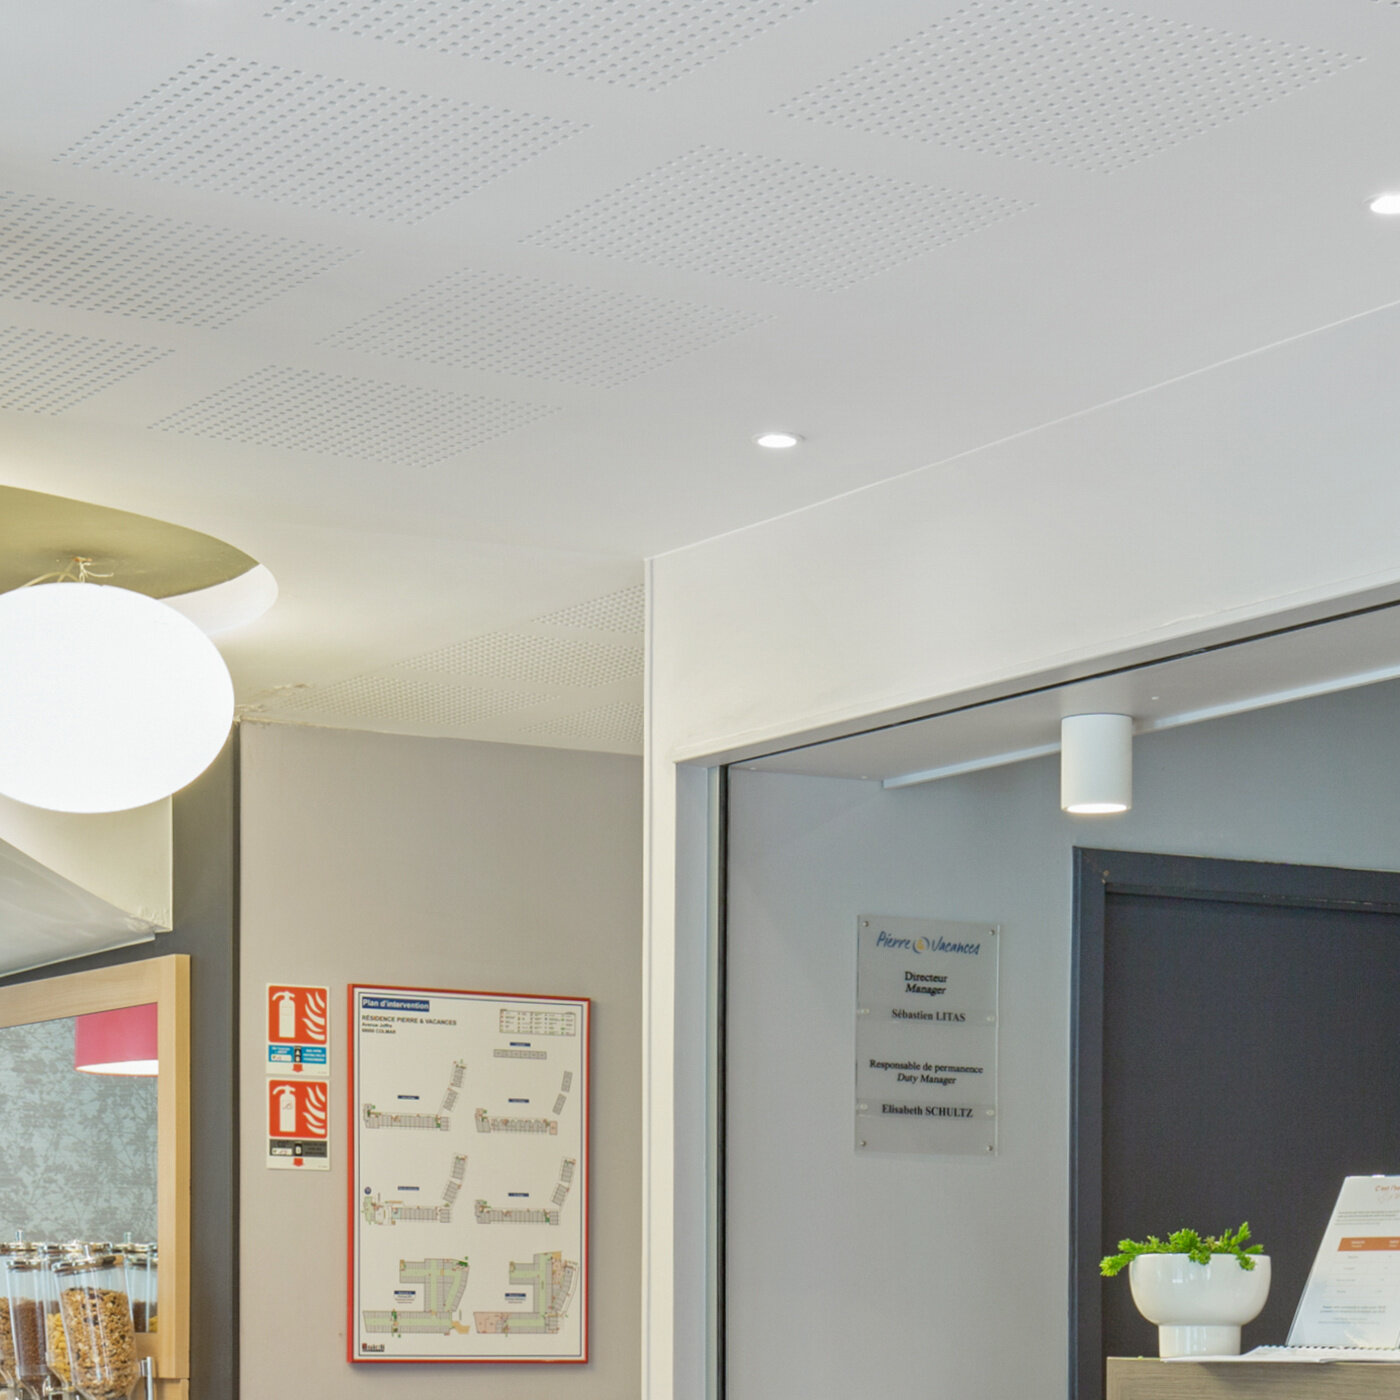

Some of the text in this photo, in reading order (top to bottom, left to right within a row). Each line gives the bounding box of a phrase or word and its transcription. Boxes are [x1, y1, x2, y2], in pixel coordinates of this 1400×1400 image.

[876, 931, 911, 949] Pierre
[931, 936, 981, 955] Vacances
[904, 971, 948, 983] Directeur
[905, 983, 946, 996] Manager
[362, 999, 429, 1010] Plan d'intervention
[891, 1008, 966, 1022] Sébastien LITAS
[869, 1059, 984, 1074] Responsable de permanence
[897, 1073, 957, 1086] Duty Manager
[882, 1104, 974, 1118] Elisabeth SCHULTZ
